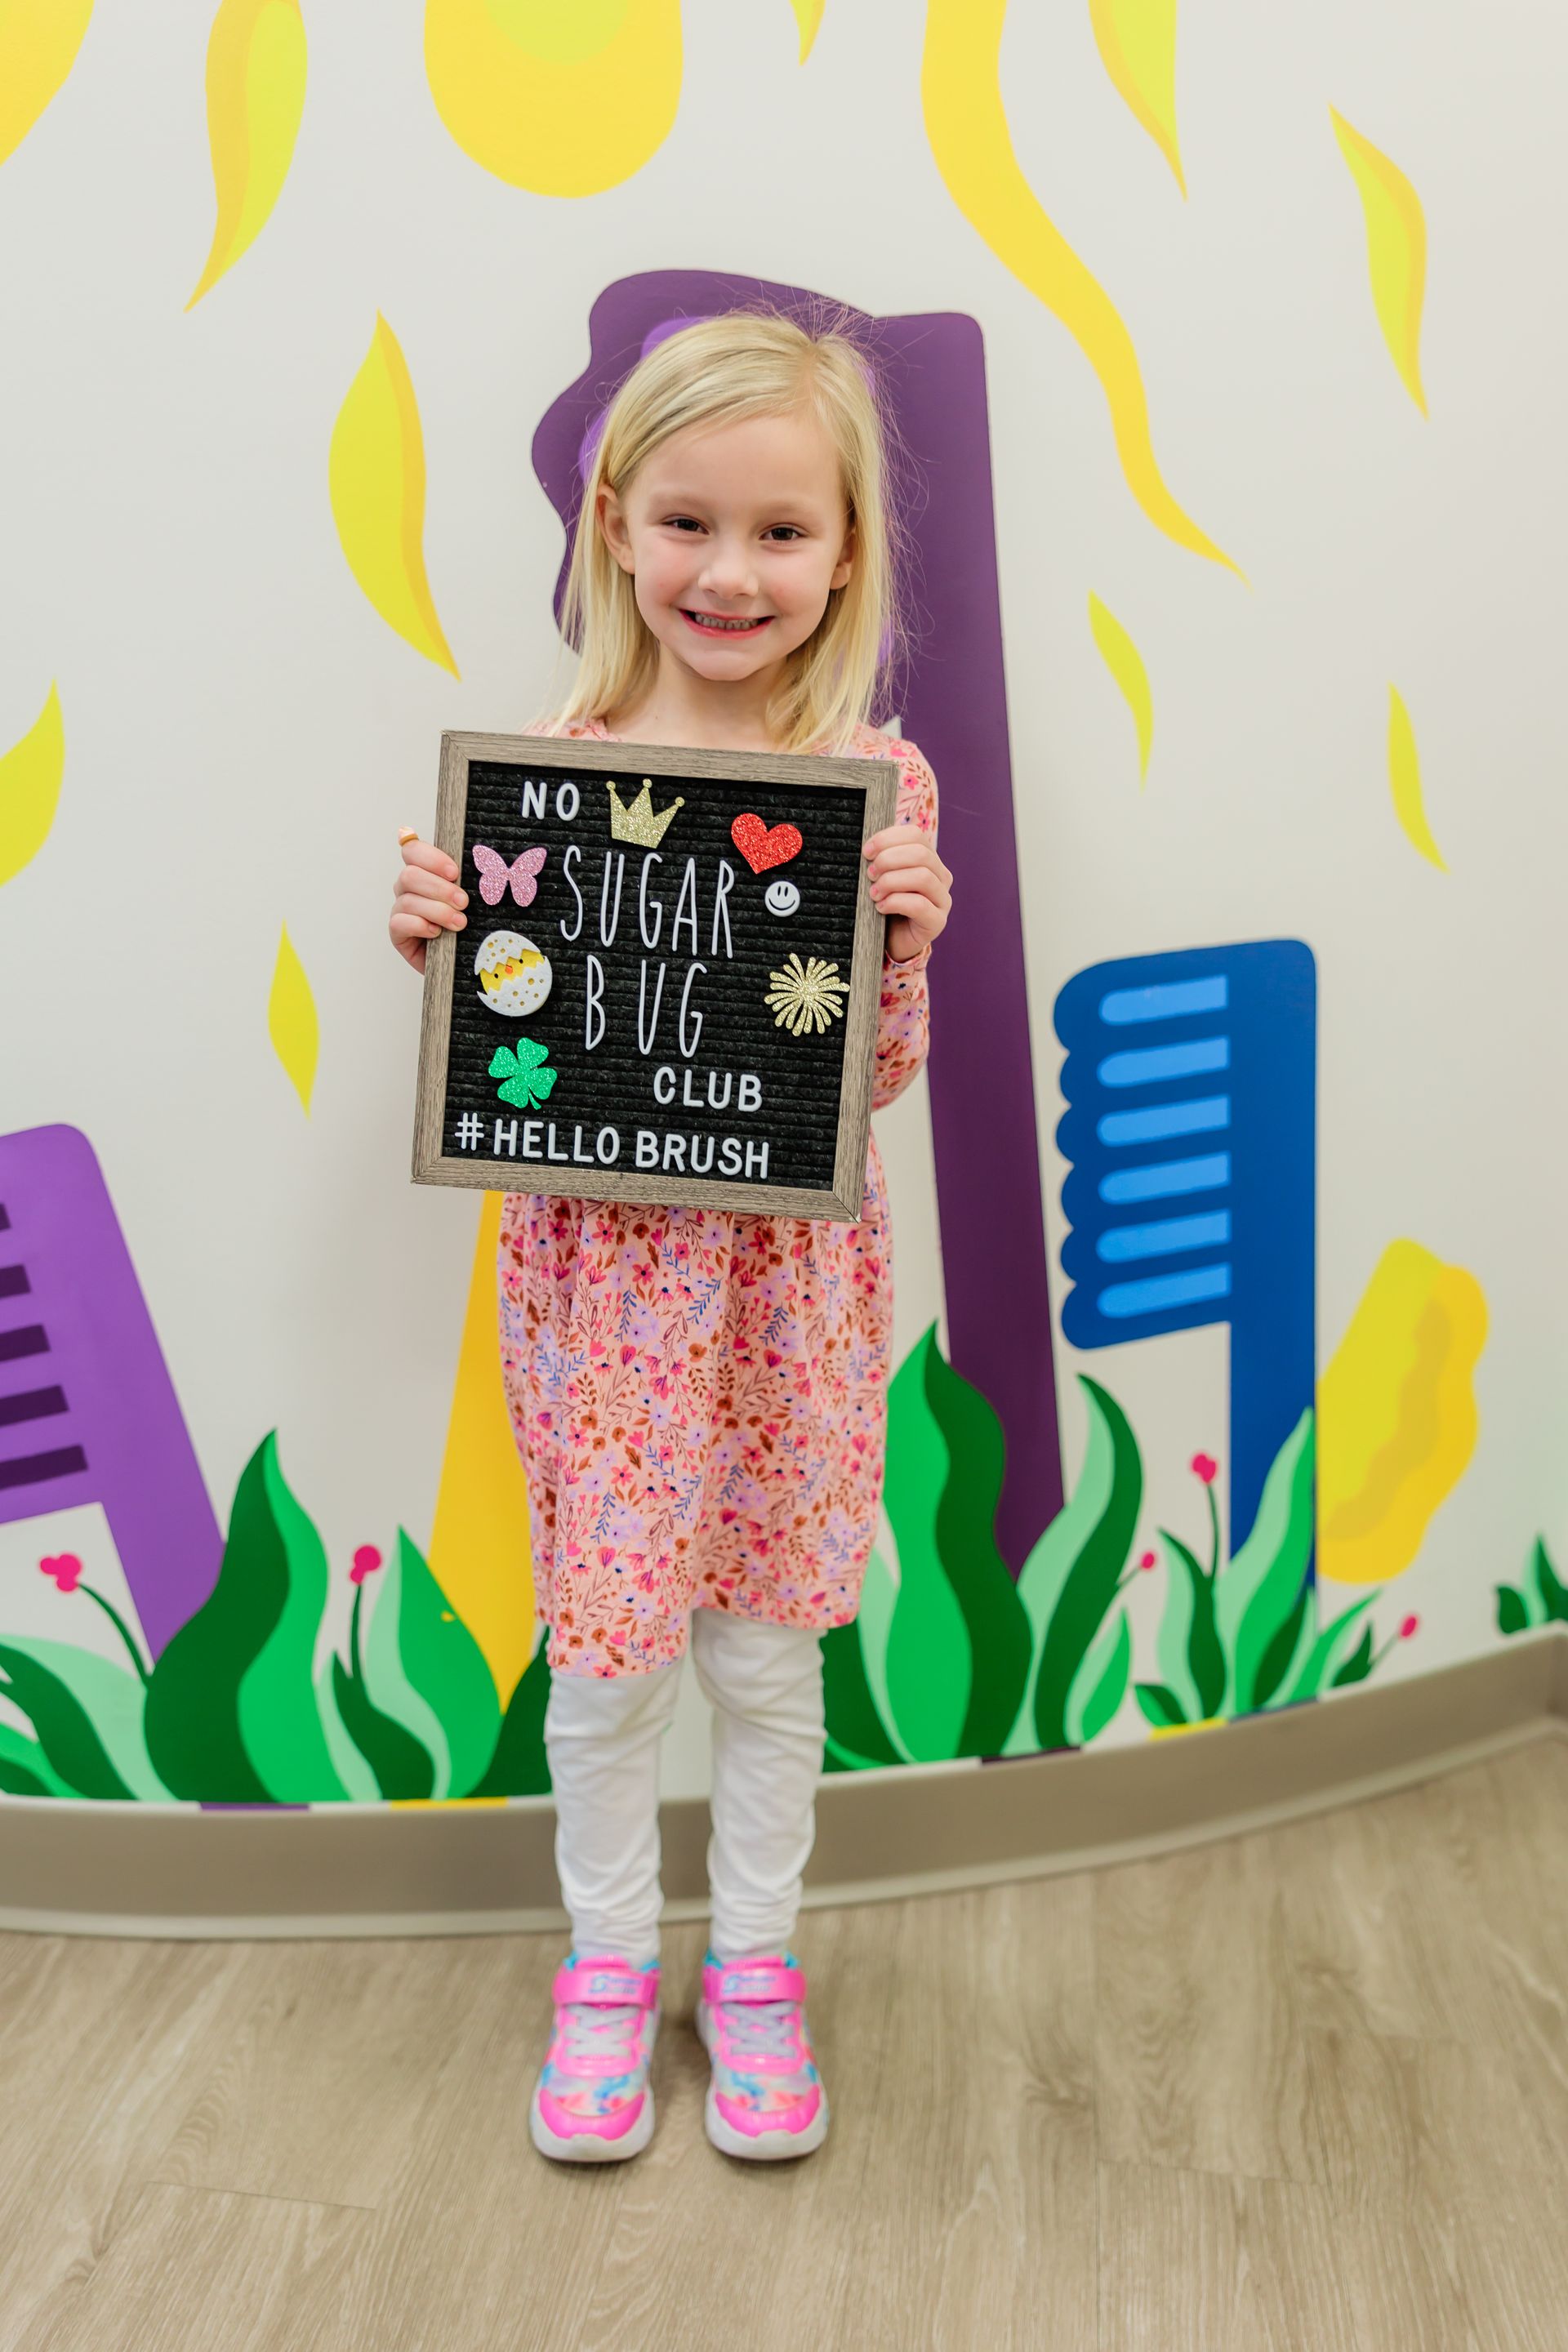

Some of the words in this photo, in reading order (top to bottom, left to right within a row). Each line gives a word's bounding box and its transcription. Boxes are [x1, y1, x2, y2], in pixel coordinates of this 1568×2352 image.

[521, 781, 580, 821] NO
[560, 844, 735, 959] SUGAR
[653, 1066, 763, 1112] CLUB
[635, 1130, 769, 1179] BRUSH
